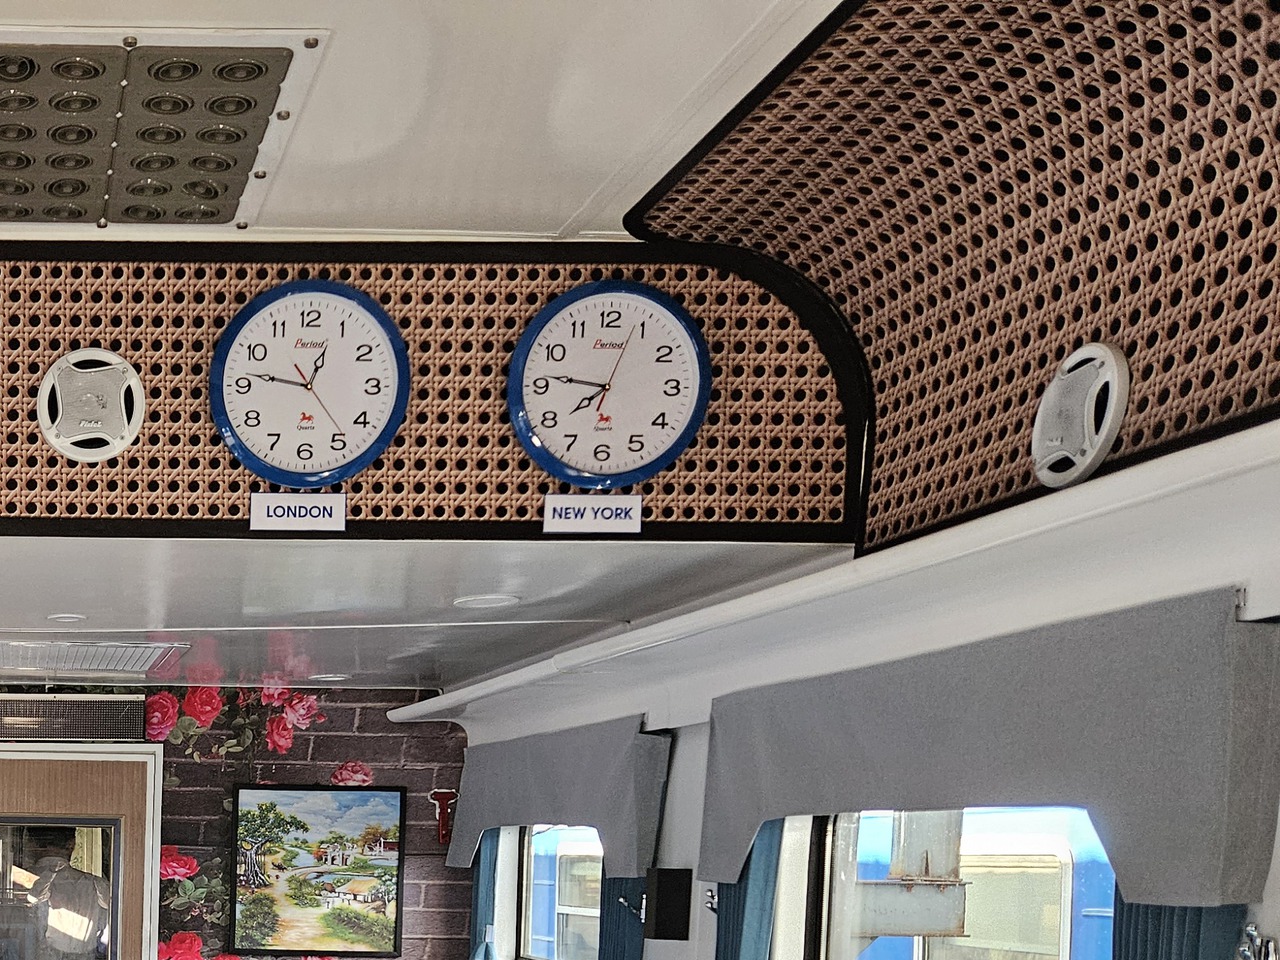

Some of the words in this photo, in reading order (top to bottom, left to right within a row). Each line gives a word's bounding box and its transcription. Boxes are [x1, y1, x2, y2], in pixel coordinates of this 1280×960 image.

[300, 310, 321, 327] 12
[600, 311, 621, 328] 12
[272, 320, 286, 338] 11
[340, 320, 345, 338] 1
[572, 320, 585, 338] 11
[640, 321, 645, 339] 1
[247, 344, 267, 361] 10
[546, 344, 566, 361] 10
[593, 339, 624, 349] Period
[355, 345, 373, 361] 2
[655, 346, 673, 363] 2
[235, 377, 252, 394] 9
[364, 378, 381, 395] 3
[533, 378, 549, 394] 9
[663, 379, 680, 396] 3
[244, 410, 261, 427] 8
[353, 411, 370, 428] 4
[541, 410, 558, 428] 8
[651, 413, 669, 429] 4
[267, 434, 280, 451] 7
[330, 434, 347, 450] 5
[564, 435, 578, 452] 7
[628, 435, 645, 452] 5
[297, 443, 313, 460] 6
[593, 444, 610, 461] 6
[266, 505, 333, 518] LONDON
[552, 507, 586, 520] NEW
[592, 507, 633, 520] YORK
